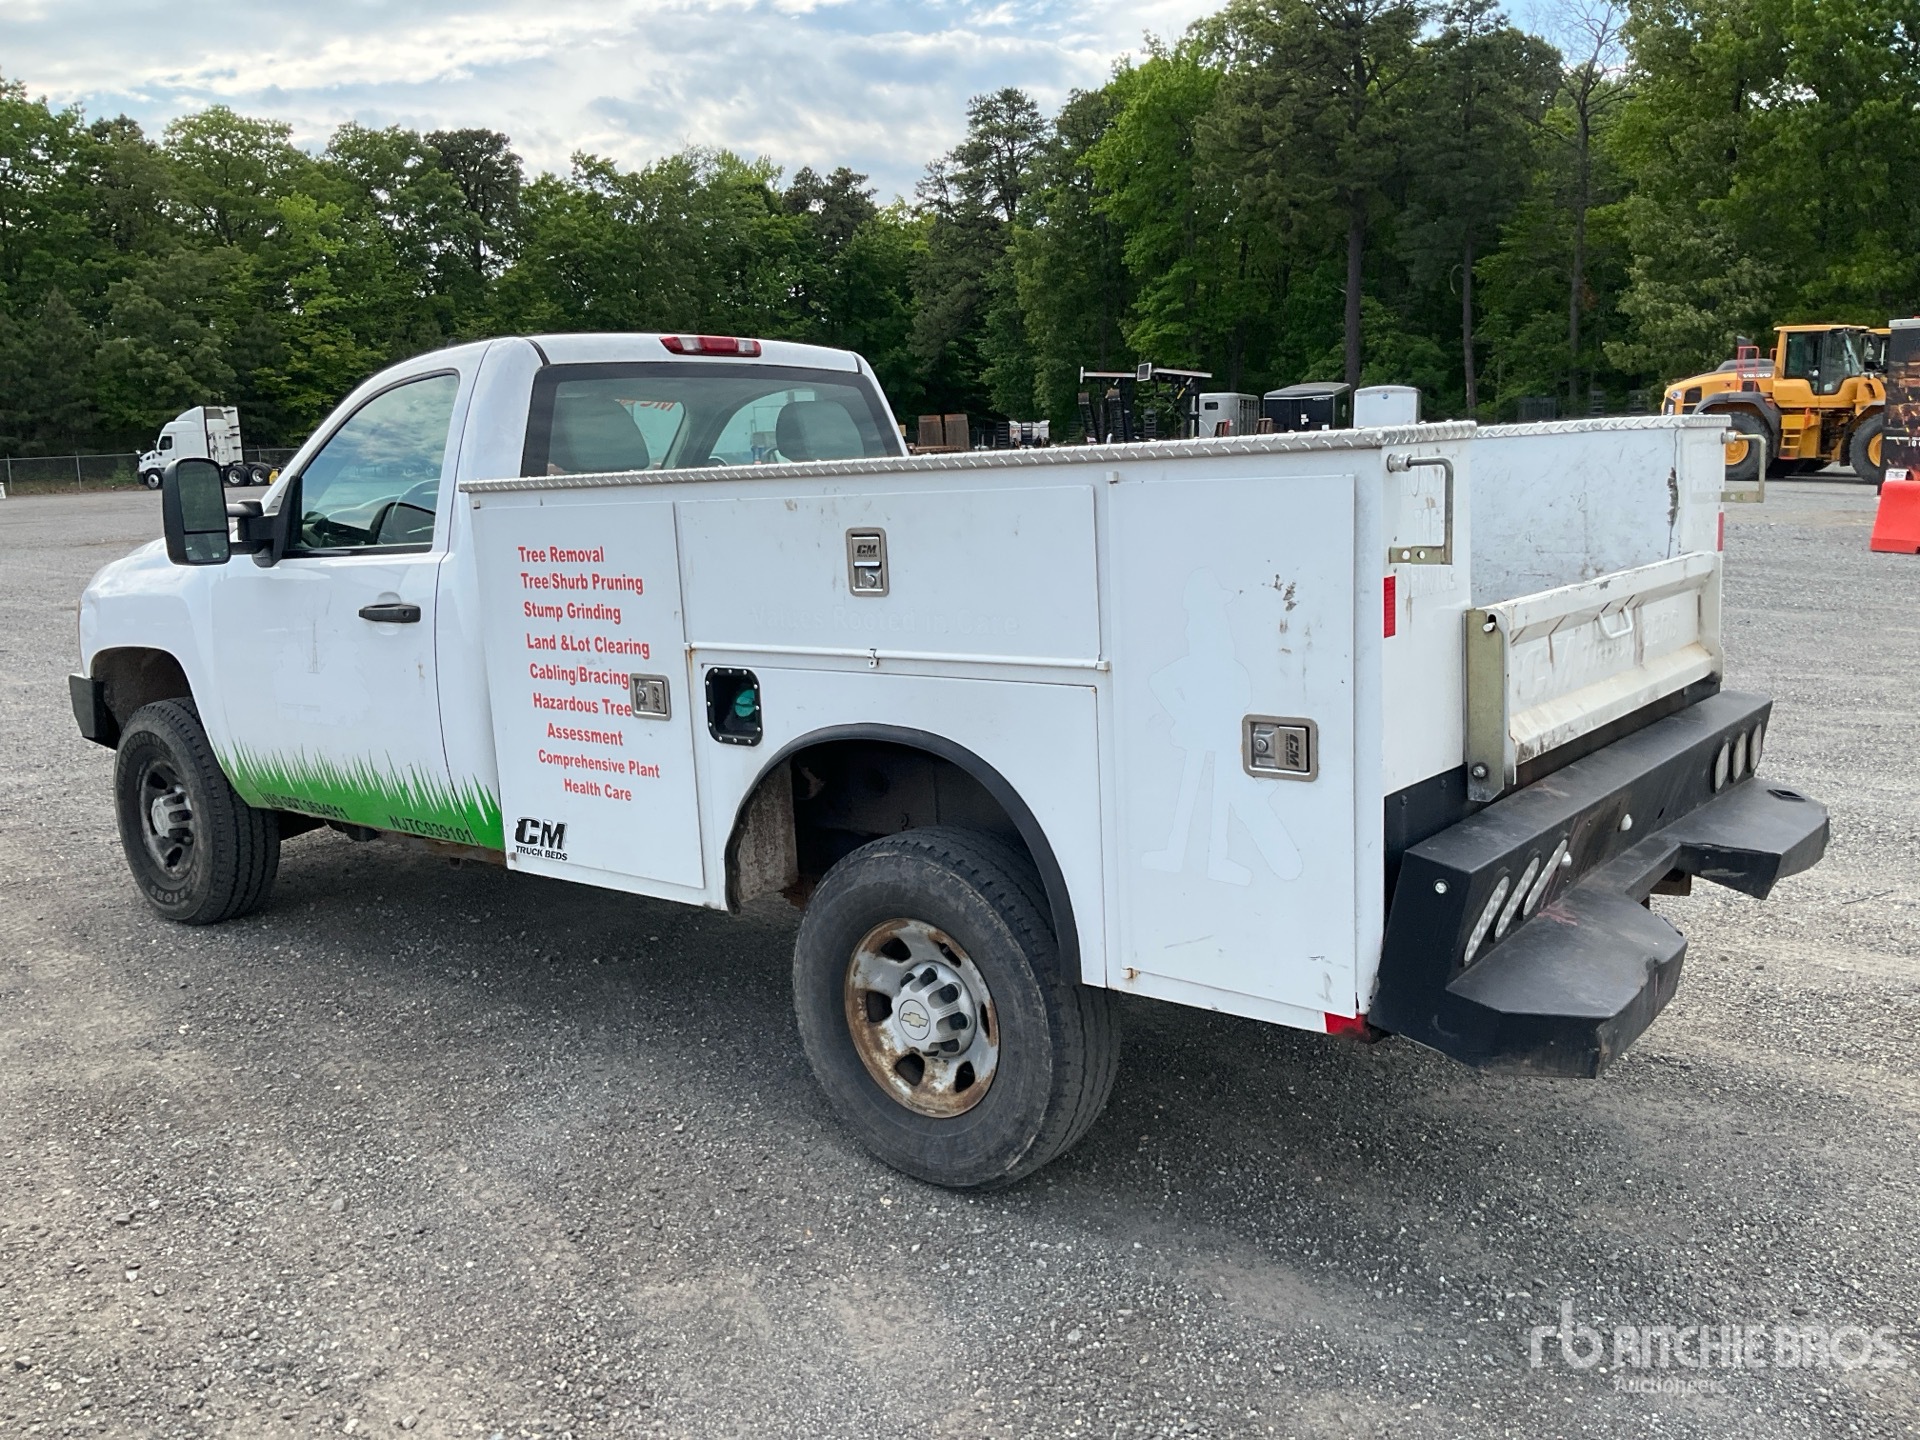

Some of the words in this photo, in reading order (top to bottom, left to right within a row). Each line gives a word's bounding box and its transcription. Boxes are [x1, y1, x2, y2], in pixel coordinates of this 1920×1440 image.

[518, 546, 546, 562] Tree
[550, 546, 604, 562] Removal
[521, 572, 588, 589] Tree/Shurb
[592, 573, 644, 595] Pruning
[524, 601, 563, 622] Stump
[567, 602, 621, 625] Grinding
[526, 633, 556, 650] Land
[561, 634, 590, 652] &Lot
[594, 636, 650, 660] Clearing
[530, 663, 629, 690] Cabling/Bracing
[533, 692, 598, 714] Hazardous
[602, 699, 632, 716] Tree
[547, 722, 624, 746] Assessment
[538, 749, 625, 773] Comprehensive
[629, 760, 660, 778] Plant
[564, 778, 601, 796] Health
[604, 784, 632, 801] Care
[389, 815, 474, 844] NJTC939101
[515, 818, 566, 850] CM
[516, 846, 543, 857] TRUCK
[545, 850, 568, 861] BEDS
